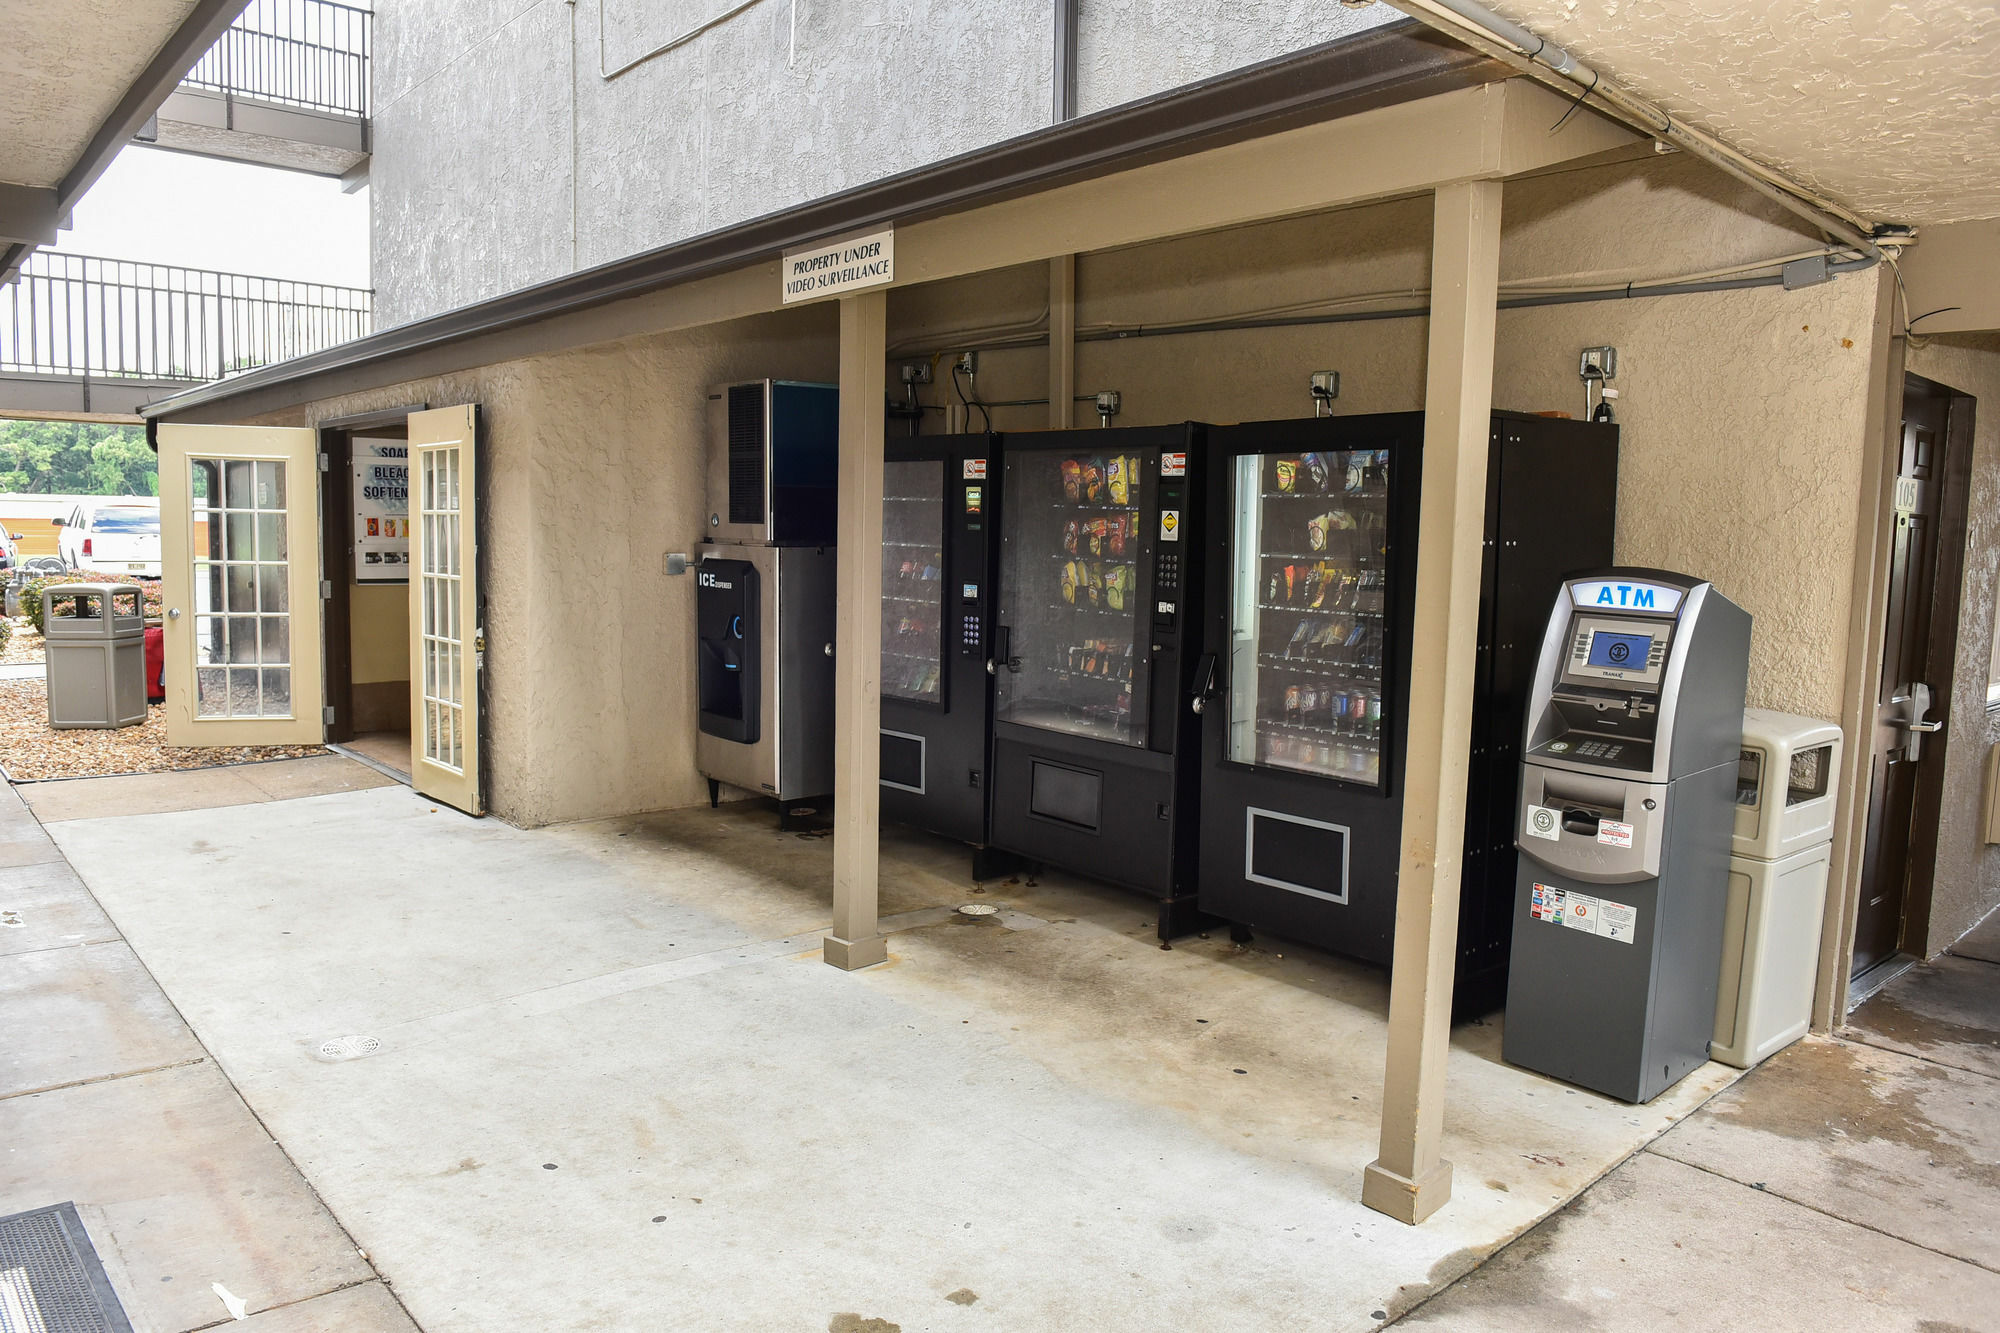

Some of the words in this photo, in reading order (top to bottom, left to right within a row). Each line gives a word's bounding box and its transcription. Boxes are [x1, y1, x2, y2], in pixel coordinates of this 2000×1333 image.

[793, 252, 842, 275] PROPERTY
[844, 242, 881, 263] UNDER
[787, 276, 815, 295] VIDEO
[818, 259, 889, 288] SURVEILLANCE
[1898, 481, 1916, 508] 105
[699, 572, 716, 587] ICE
[1597, 585, 1655, 608] ATM
